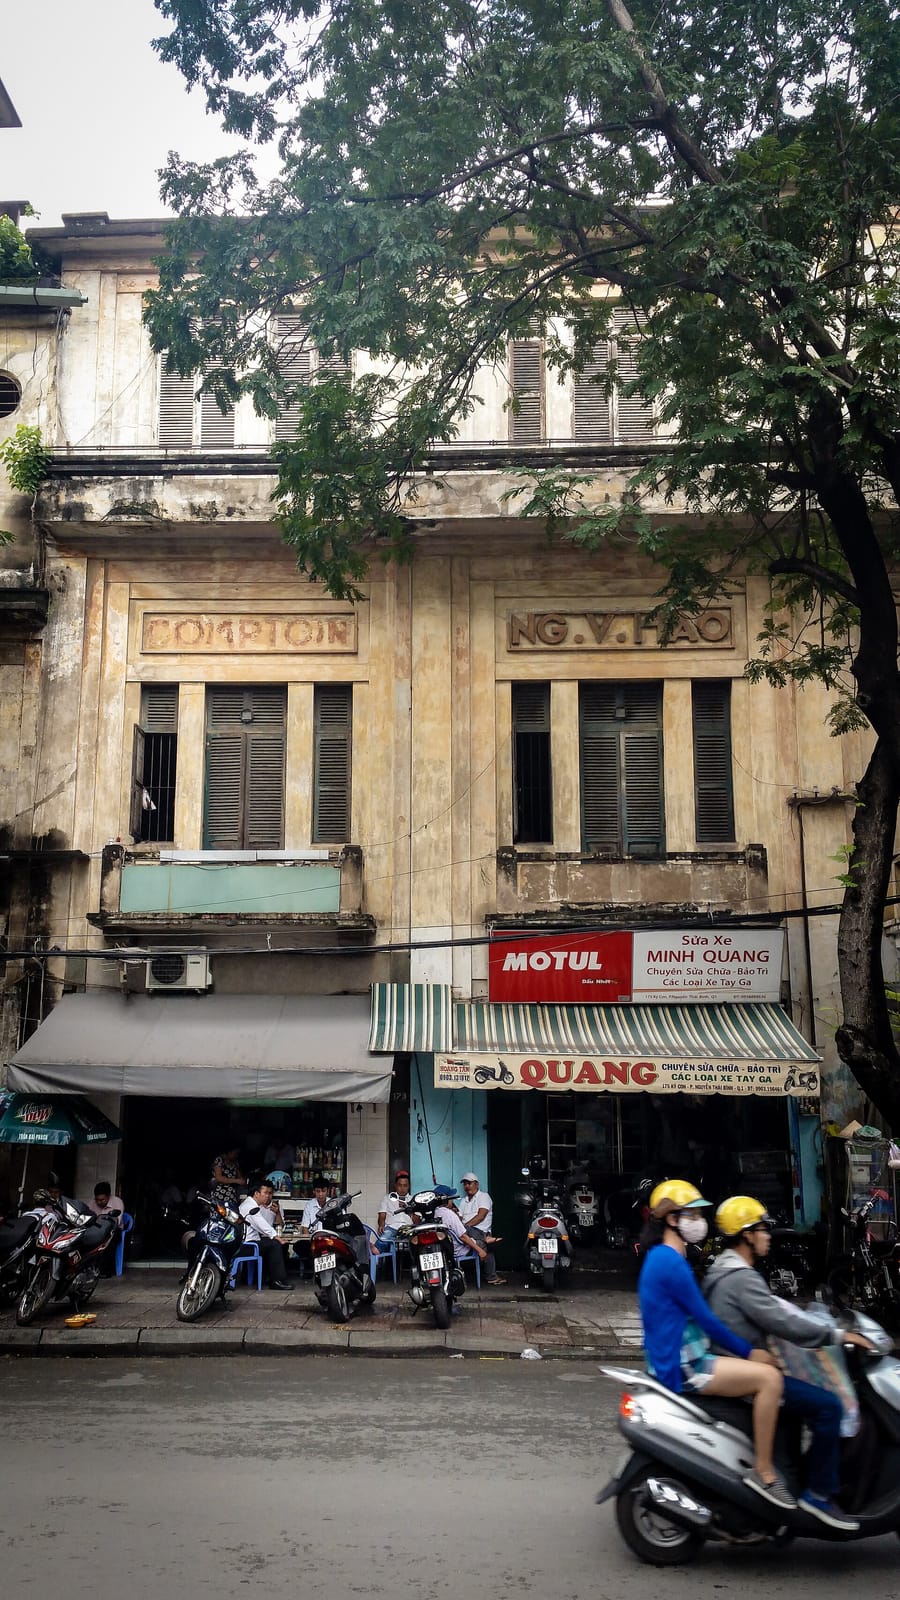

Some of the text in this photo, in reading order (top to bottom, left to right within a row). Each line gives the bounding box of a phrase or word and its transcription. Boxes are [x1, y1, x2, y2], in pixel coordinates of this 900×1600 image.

[681, 935, 732, 946] Sửa Xe
[502, 951, 602, 971] MOTUL
[647, 950, 770, 963] MINH QUANG
[646, 967, 682, 977] Chuyên
[662, 978, 679, 986] Các
[683, 978, 703, 987] Loại
[705, 978, 718, 986] Xe
[720, 979, 736, 988] Tay
[661, 1062, 695, 1071] CHUYÊN
[697, 1061, 714, 1072] SỬA
[716, 1063, 740, 1073] CHỮA
[747, 1063, 765, 1073] BẢO
[520, 1059, 659, 1088] QUANG
[671, 1071, 691, 1081] CÁC
[694, 1074, 717, 1083] LOẠI
[736, 1075, 755, 1083] TAY
[758, 1075, 772, 1083] GA
